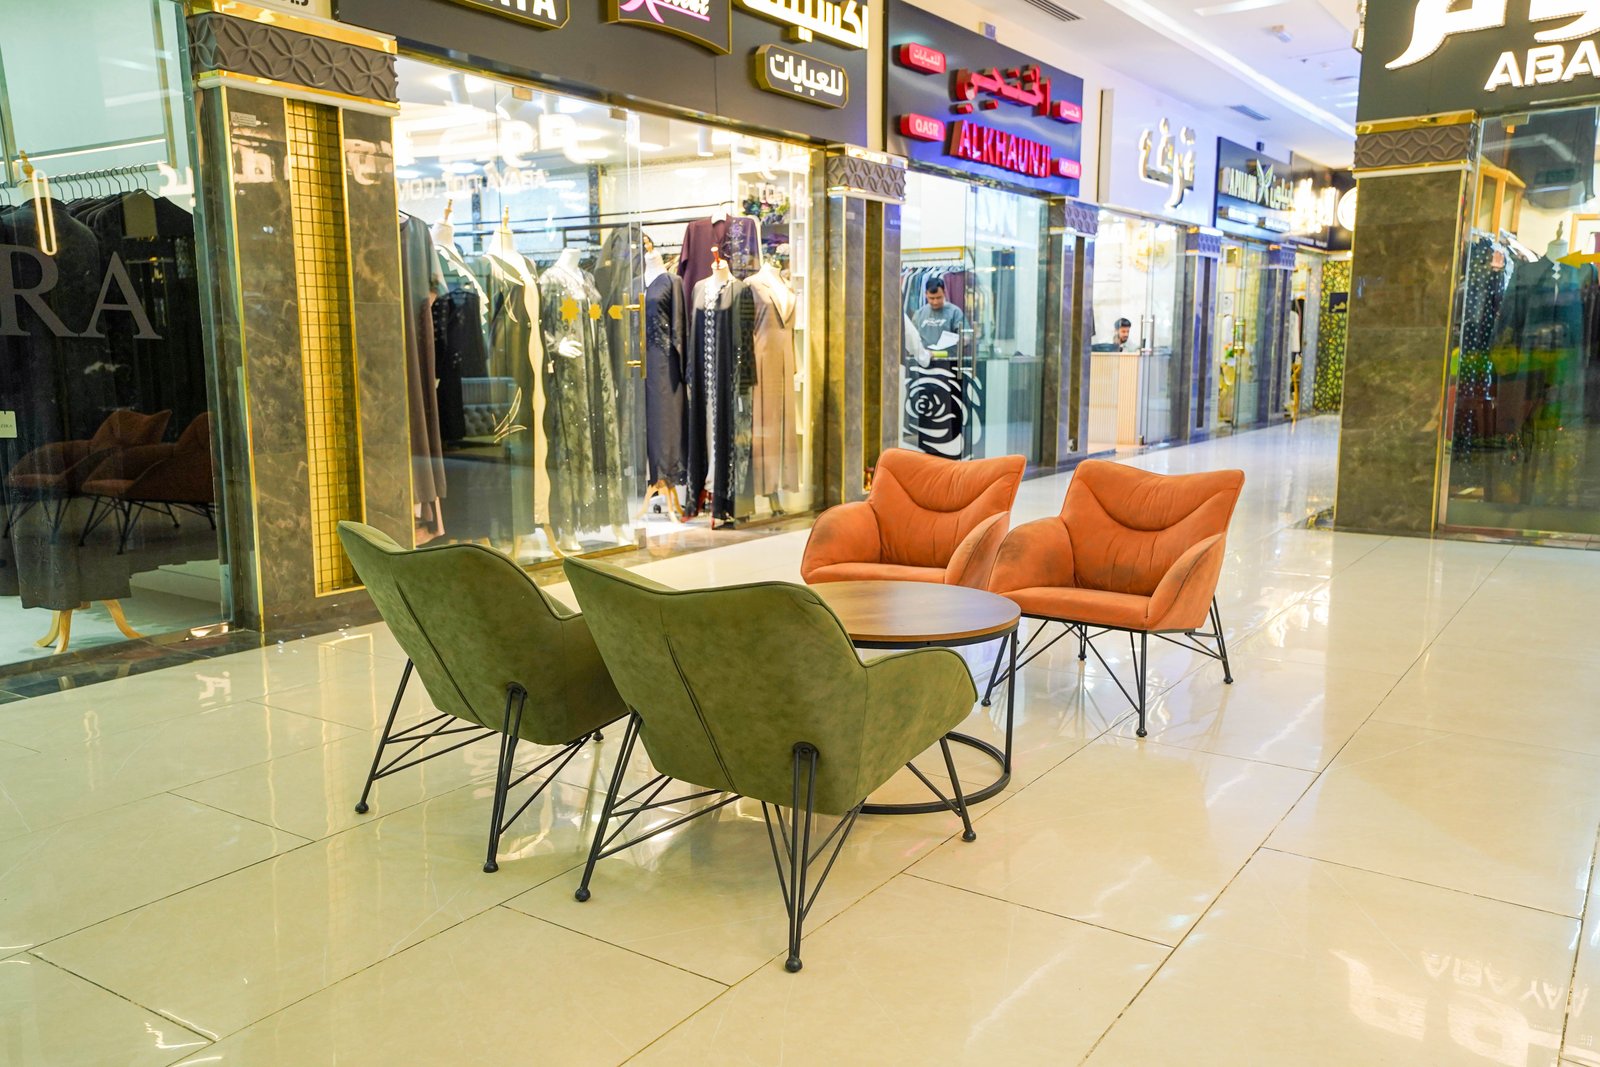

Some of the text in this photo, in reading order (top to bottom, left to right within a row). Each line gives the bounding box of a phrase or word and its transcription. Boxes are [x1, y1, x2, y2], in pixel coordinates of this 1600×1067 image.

[769, 54, 844, 96] للعبايات
[1484, 40, 1600, 91] ABA
[915, 118, 940, 137] QASR
[957, 119, 1051, 177] ALKHAUNJI
